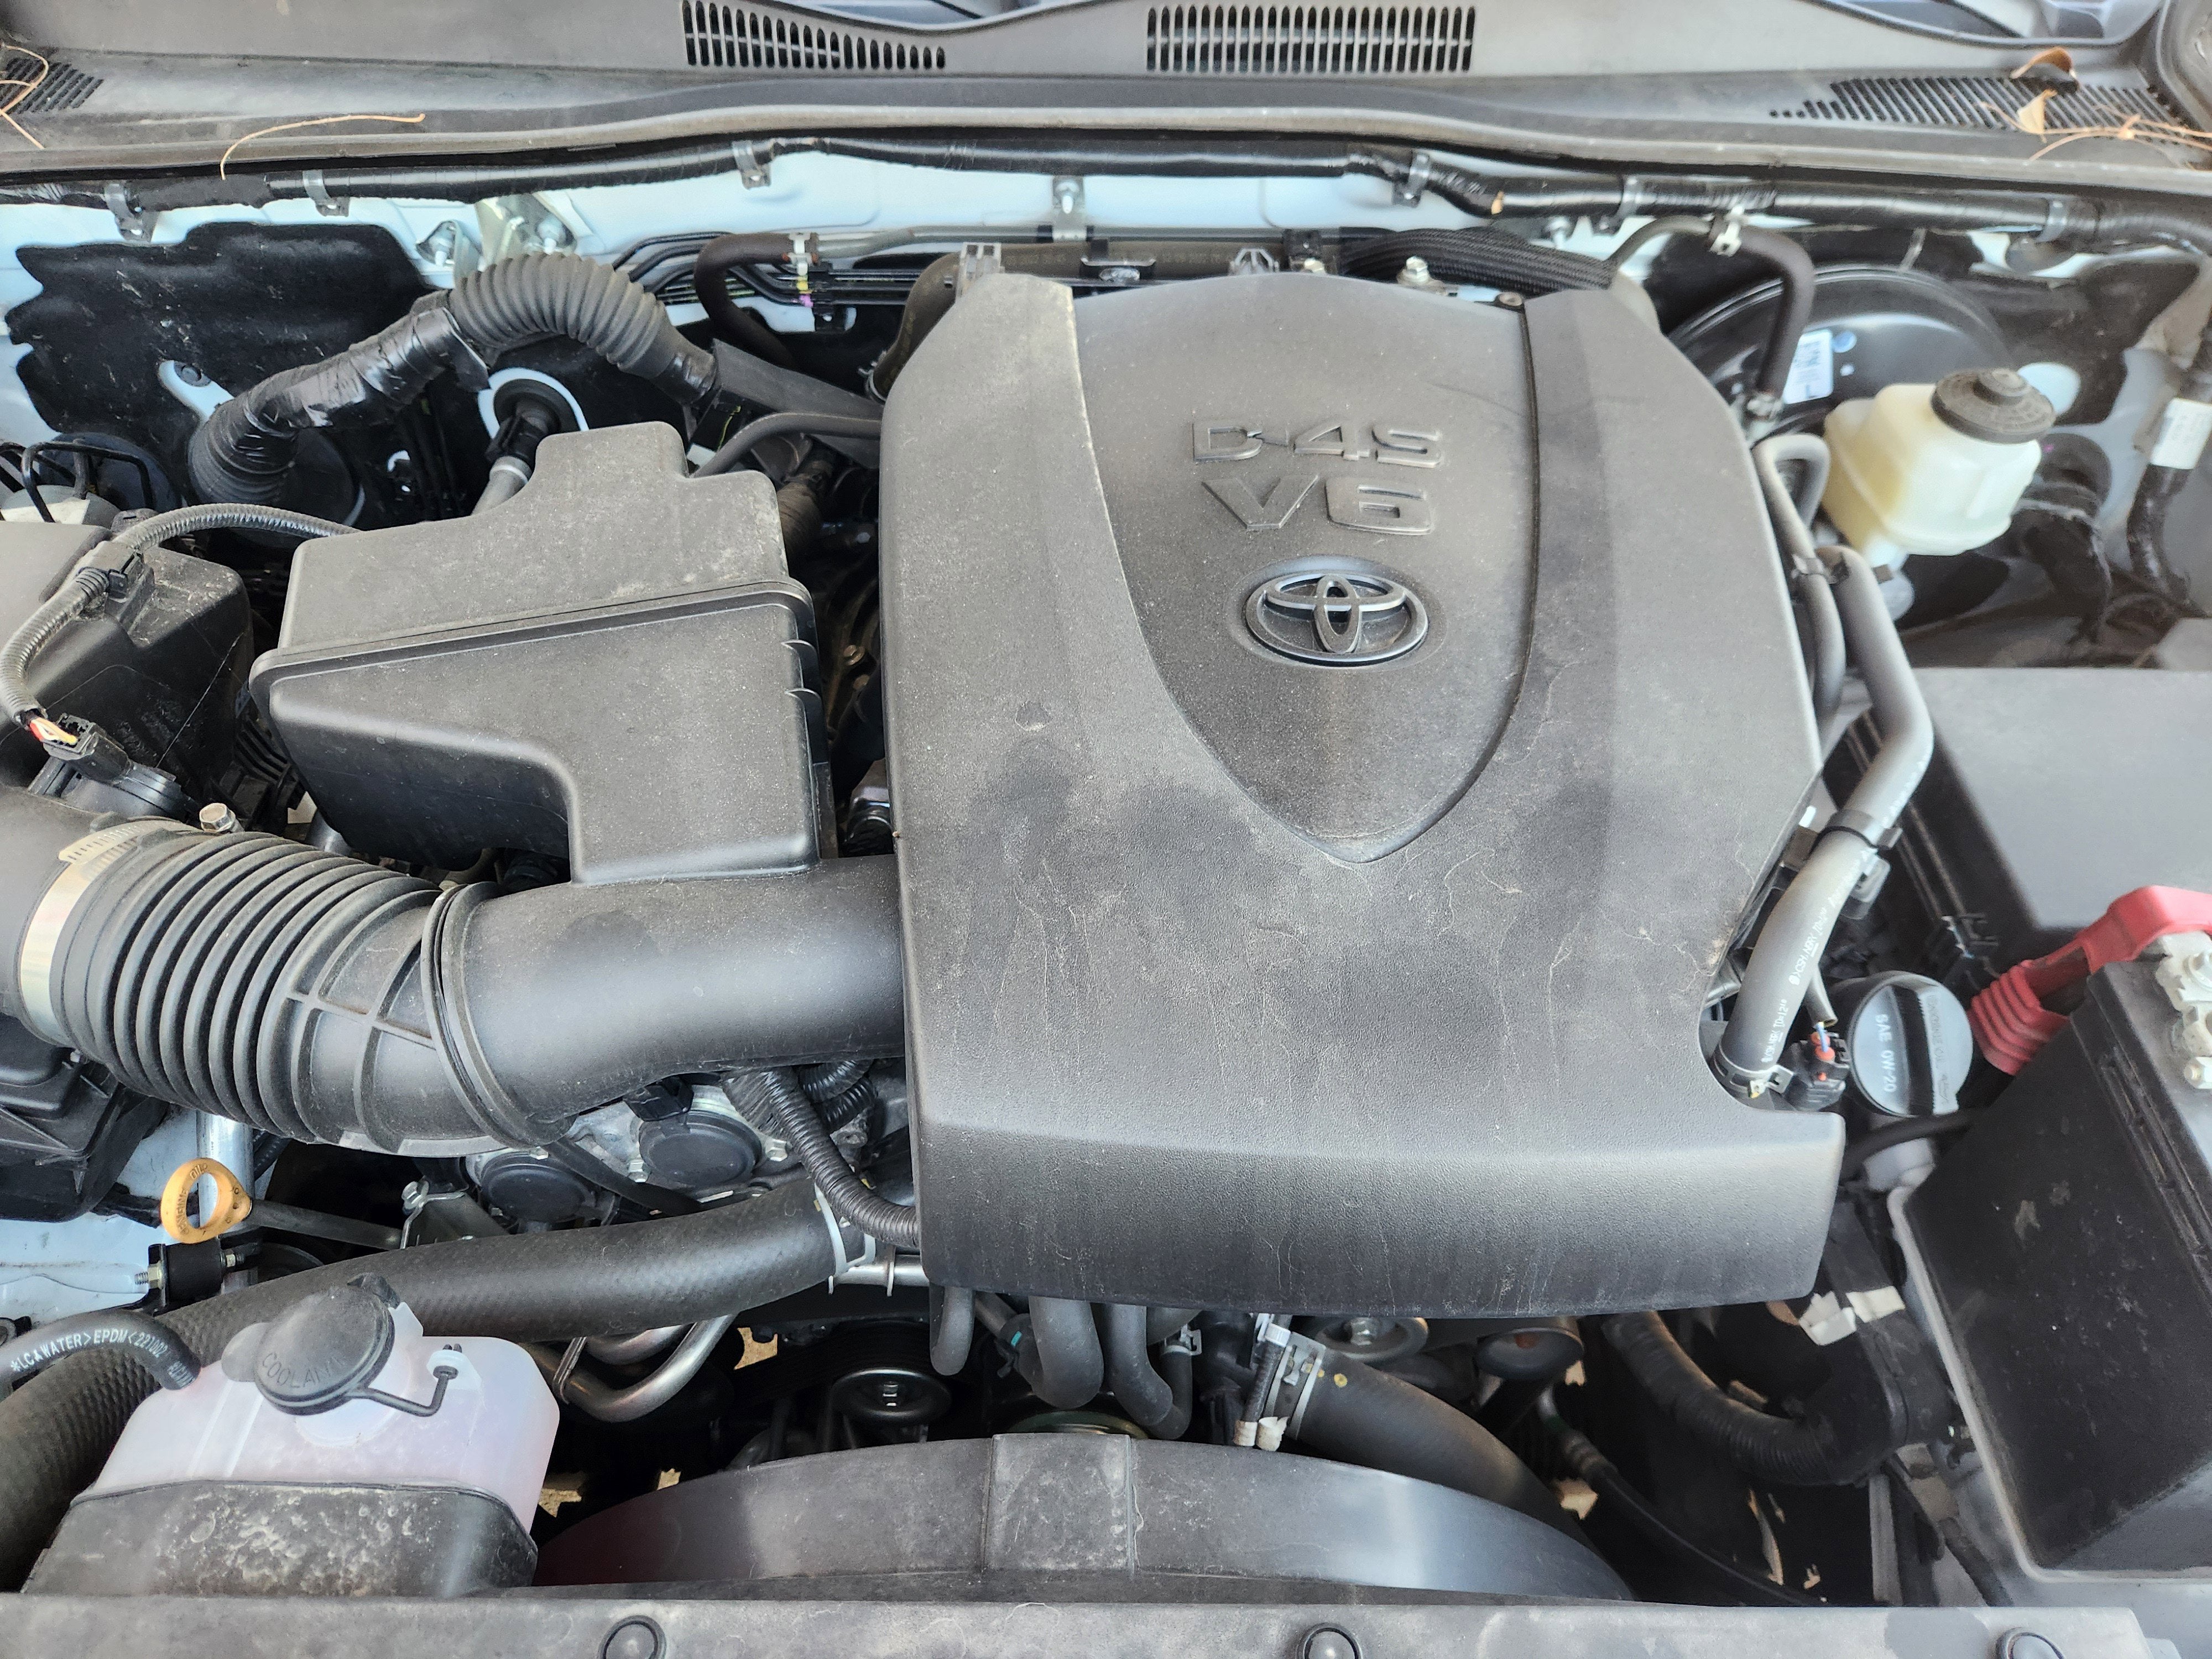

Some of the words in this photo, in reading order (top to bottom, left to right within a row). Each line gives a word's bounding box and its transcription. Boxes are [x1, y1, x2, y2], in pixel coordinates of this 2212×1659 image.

[1192, 418, 1442, 469] D-4S
[1201, 474, 1436, 536] V6
[1875, 1014, 1892, 1042] SAE
[1881, 1050, 1897, 1093] 0W-20
[190, 1164, 205, 1180] OIL
